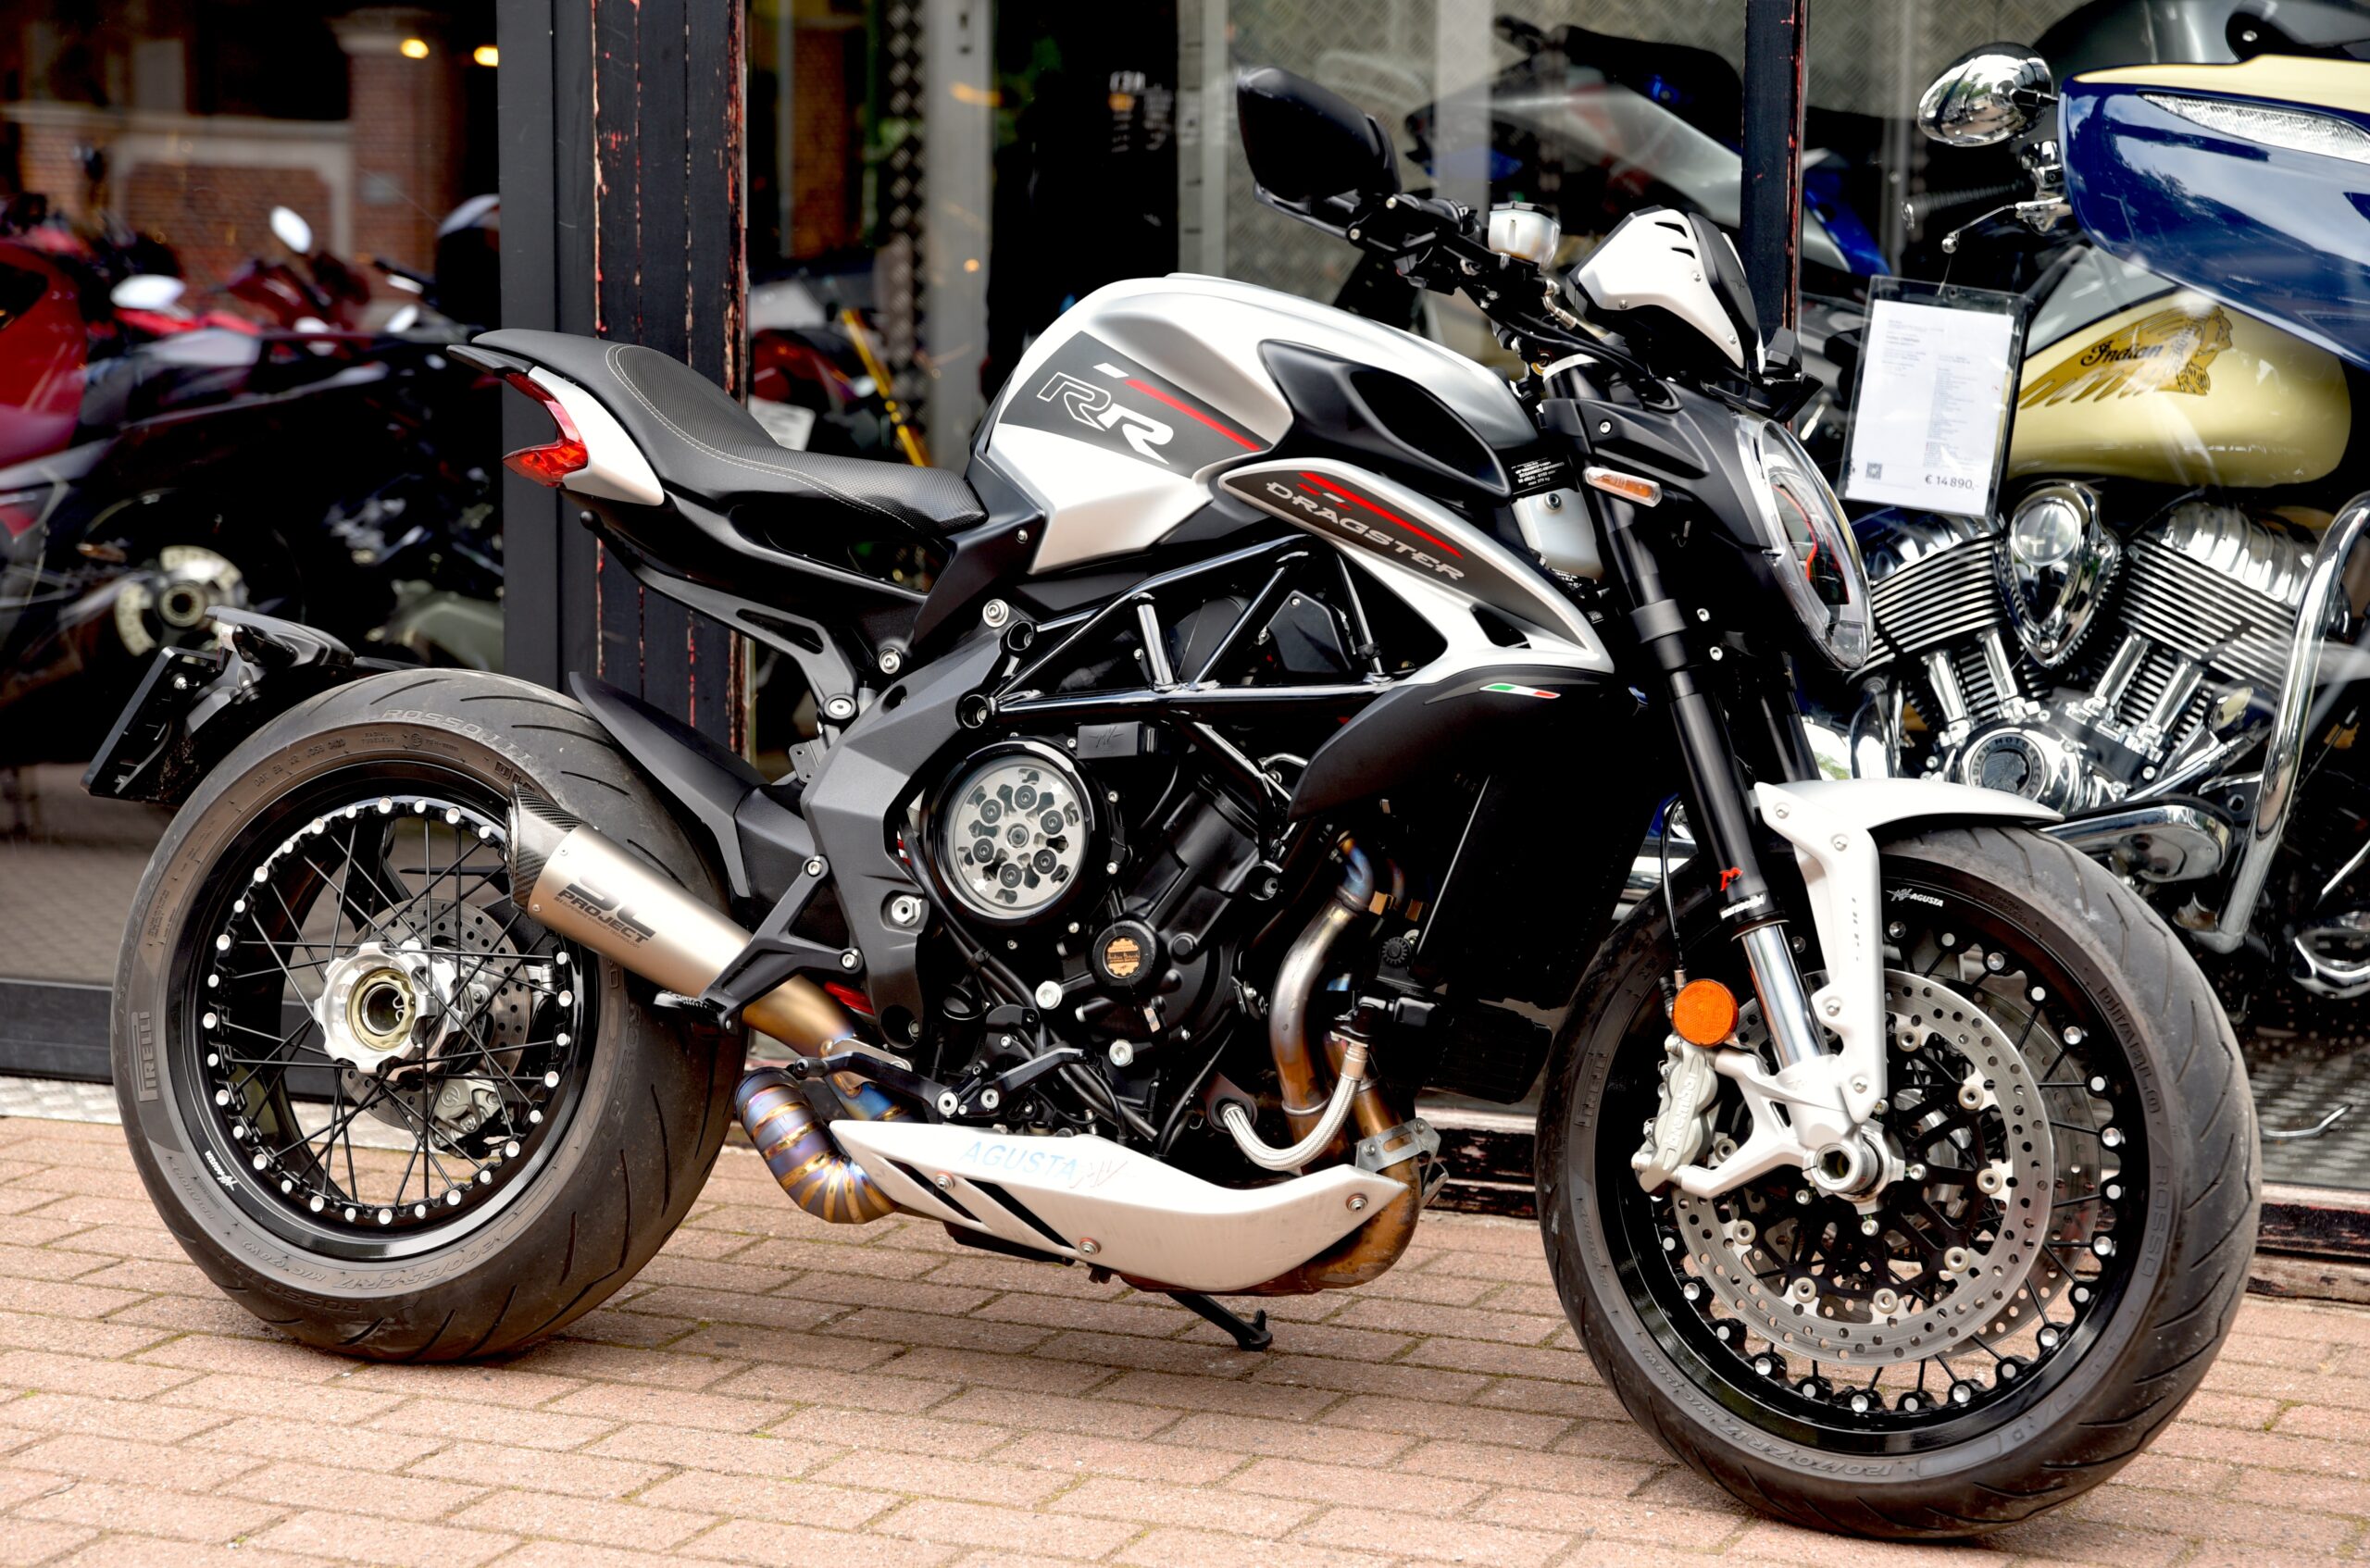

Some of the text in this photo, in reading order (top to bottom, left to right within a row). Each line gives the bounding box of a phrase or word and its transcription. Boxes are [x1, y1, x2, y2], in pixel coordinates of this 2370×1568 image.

[2080, 340, 2164, 367] Indian
[1037, 371, 1174, 465] RR
[1925, 473, 1932, 485] €
[1266, 481, 1466, 580] DRAGSTER
[1972, 744, 1990, 786] NDIAN
[556, 889, 649, 944] PROJECT
[1910, 892, 1944, 907] AGUSTA
[131, 1011, 159, 1102] PIRELLI
[958, 1140, 1079, 1181] AGUSTA
